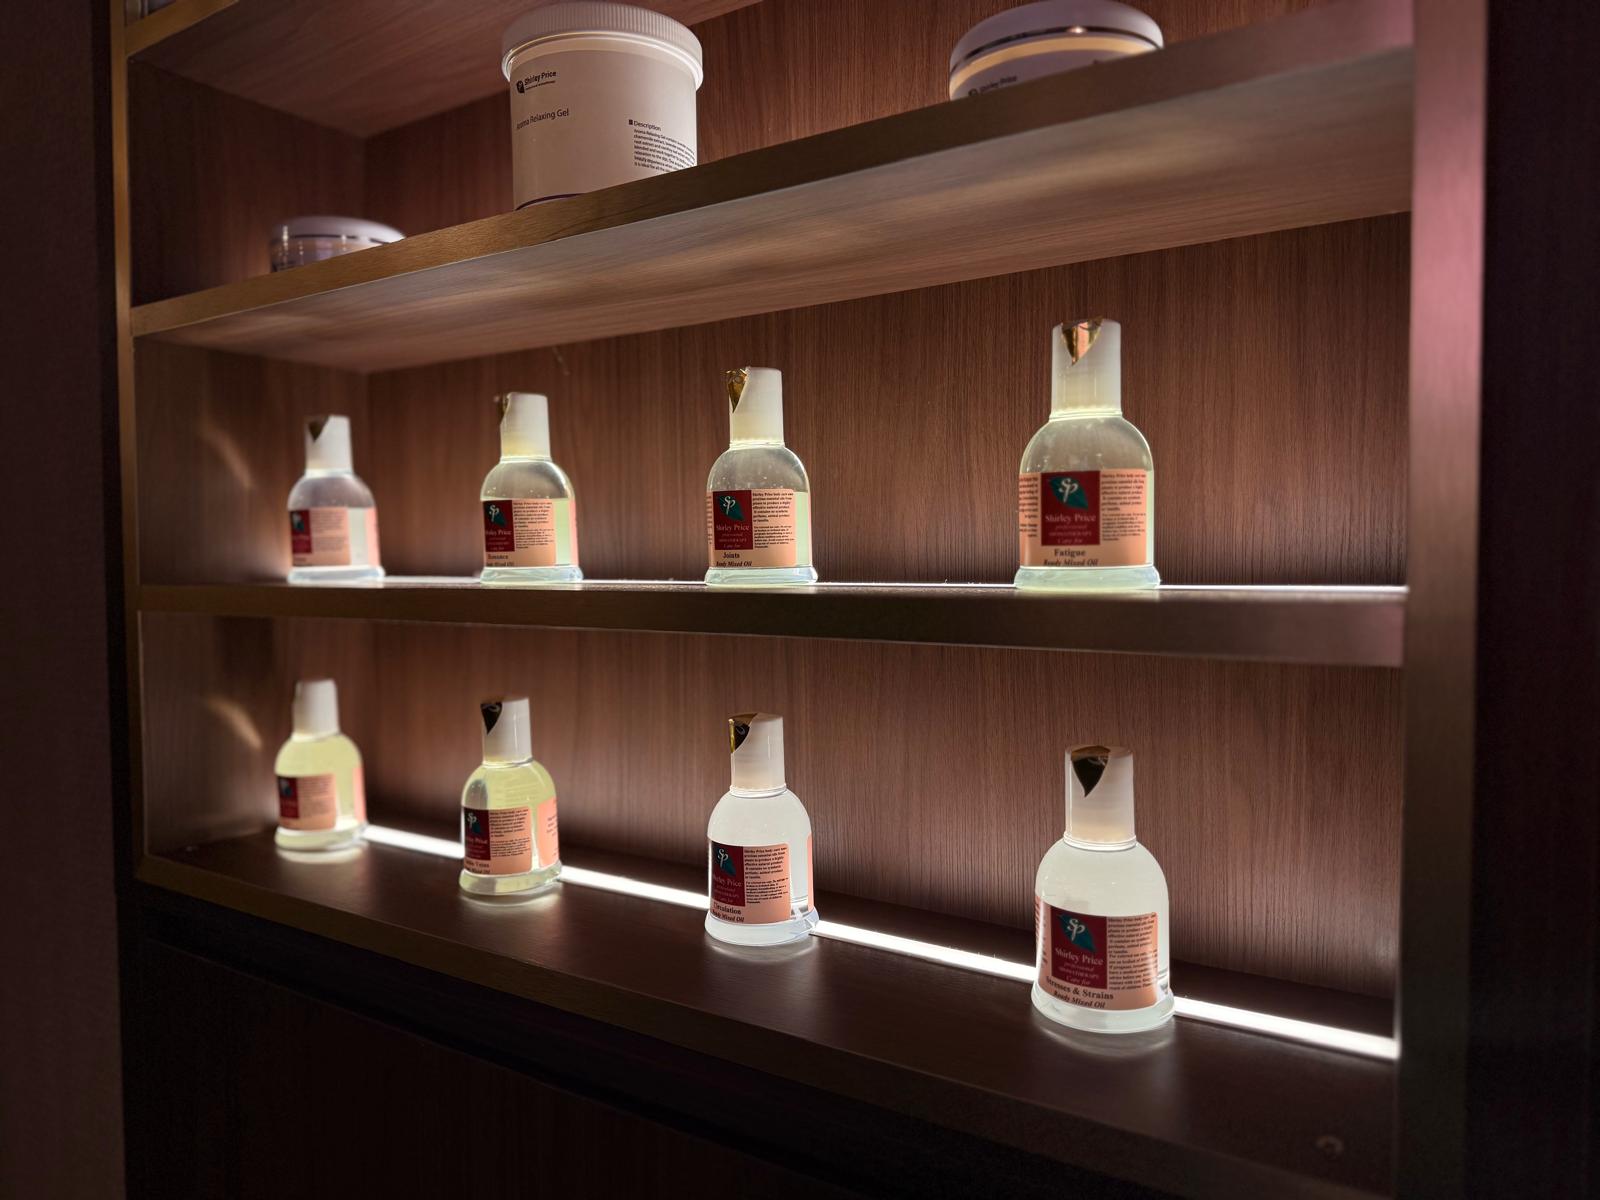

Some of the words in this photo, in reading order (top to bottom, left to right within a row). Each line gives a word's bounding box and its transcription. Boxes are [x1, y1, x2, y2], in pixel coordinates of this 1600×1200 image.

[524, 74, 540, 86] Shirley
[541, 71, 557, 79] Price
[530, 111, 556, 124] Relaxing
[556, 108, 569, 118] Gel
[634, 121, 662, 131] Description
[1044, 513, 1072, 524] Shirley
[1074, 513, 1097, 523] Price
[1053, 548, 1087, 558] Fatigue
[1062, 559, 1085, 567] Mixed
[1087, 559, 1099, 567] Oil
[1055, 947, 1080, 964] Shirley
[1082, 953, 1104, 966] Price
[1072, 987, 1080, 996] &
[1082, 989, 1114, 1001] Strains
[1072, 997, 1093, 1008] Mixed
[1094, 1001, 1106, 1009] Oil
